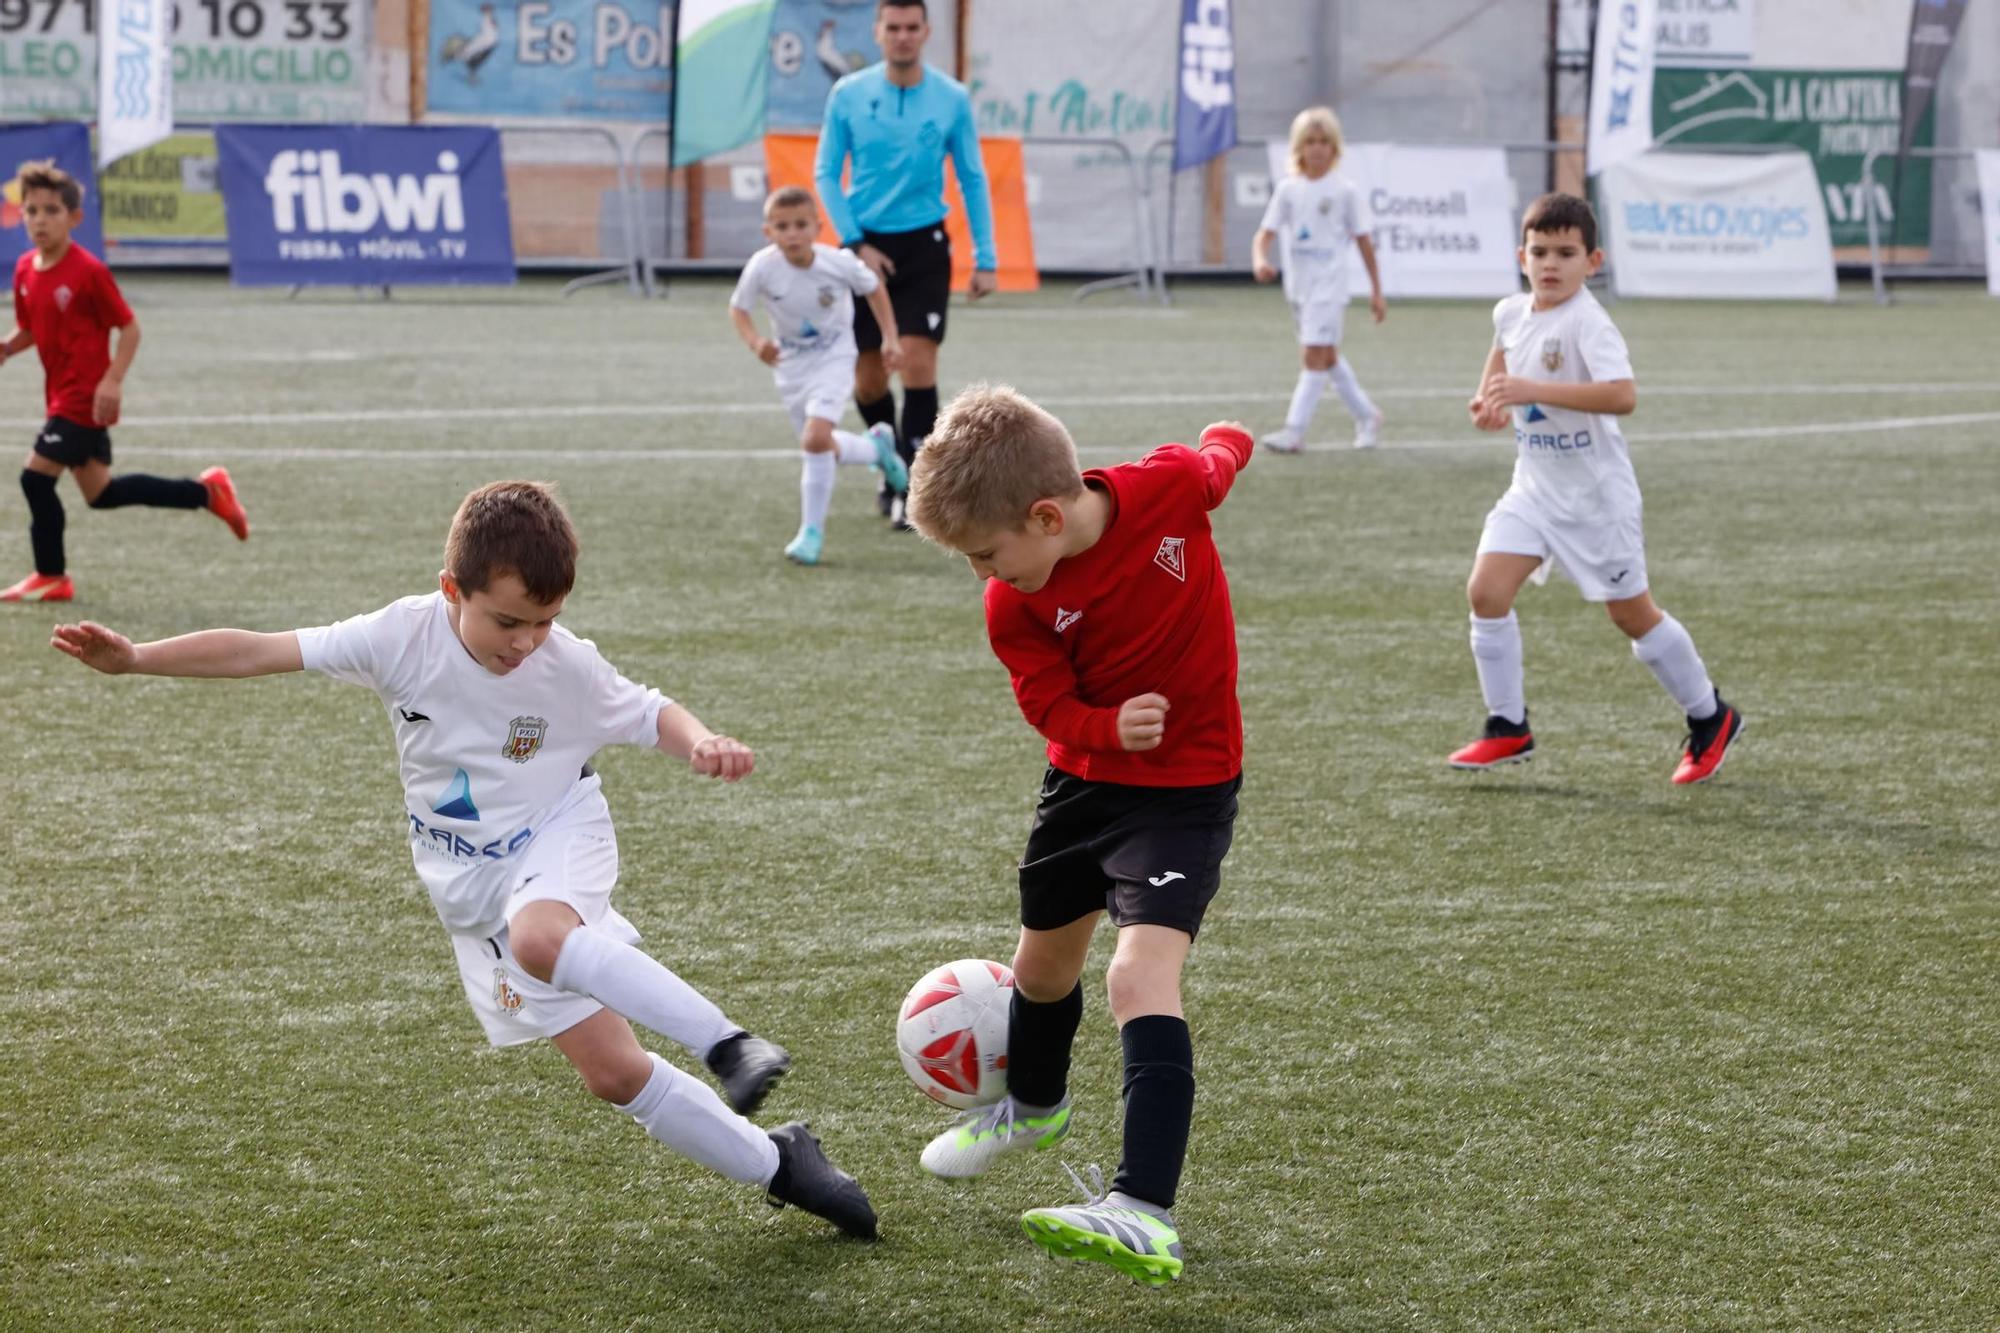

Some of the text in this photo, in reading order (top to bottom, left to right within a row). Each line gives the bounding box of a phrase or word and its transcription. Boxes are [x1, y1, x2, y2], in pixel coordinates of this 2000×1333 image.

[285, 1, 349, 40] 33
[517, 2, 576, 65] Es
[1774, 78, 1899, 122] LA CANTINA
[264, 149, 466, 233] fibwi
[1369, 188, 1468, 217] Consell
[278, 239, 345, 260] FIBRA
[438, 238, 467, 260] TV
